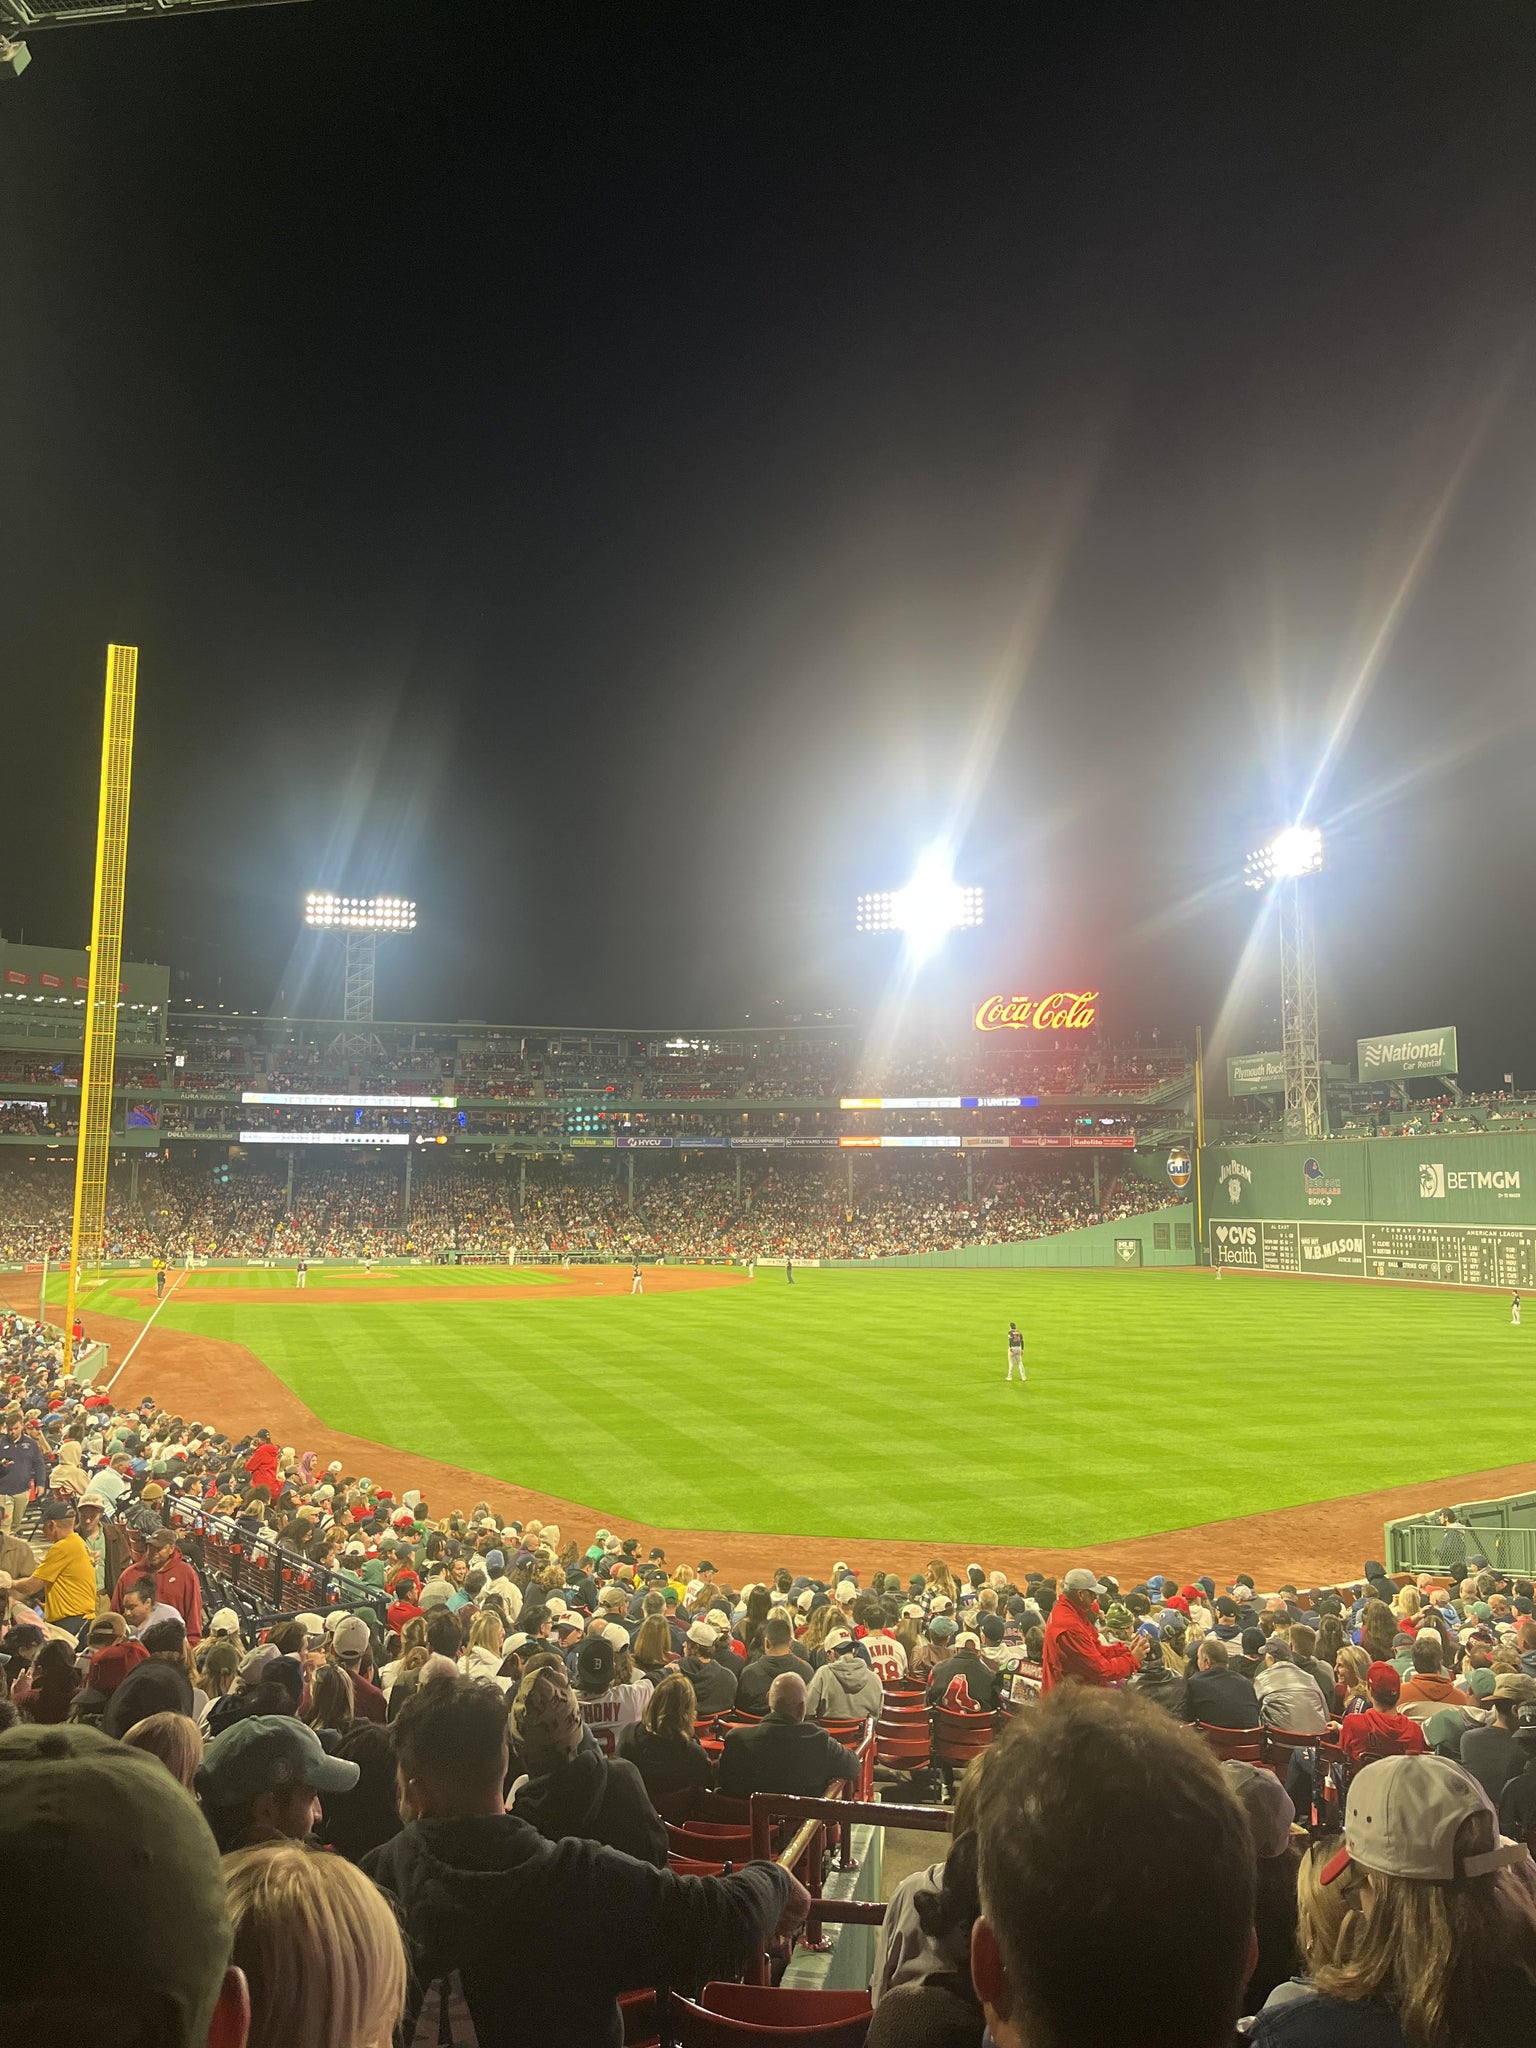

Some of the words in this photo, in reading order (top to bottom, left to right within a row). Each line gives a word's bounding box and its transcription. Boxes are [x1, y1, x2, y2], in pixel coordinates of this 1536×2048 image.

[976, 991, 1099, 1031] Coca-Cola
[1381, 1037, 1445, 1063] National
[1233, 1064, 1265, 1080] Plymouth
[1265, 1061, 1285, 1075] Rock
[1402, 1062, 1416, 1071] Car
[1417, 1058, 1442, 1070] Rental
[638, 1138, 661, 1146] HYCU
[1167, 1161, 1190, 1174] Gulf
[1219, 1164, 1232, 1184] JIM
[1231, 1159, 1252, 1184] BEAM
[1447, 1171, 1520, 1189] BETMGM
[1228, 1226, 1257, 1245] CVS
[1218, 1245, 1258, 1265] Health
[868, 1644, 894, 1658] KWAN
[593, 1657, 602, 1670] B
